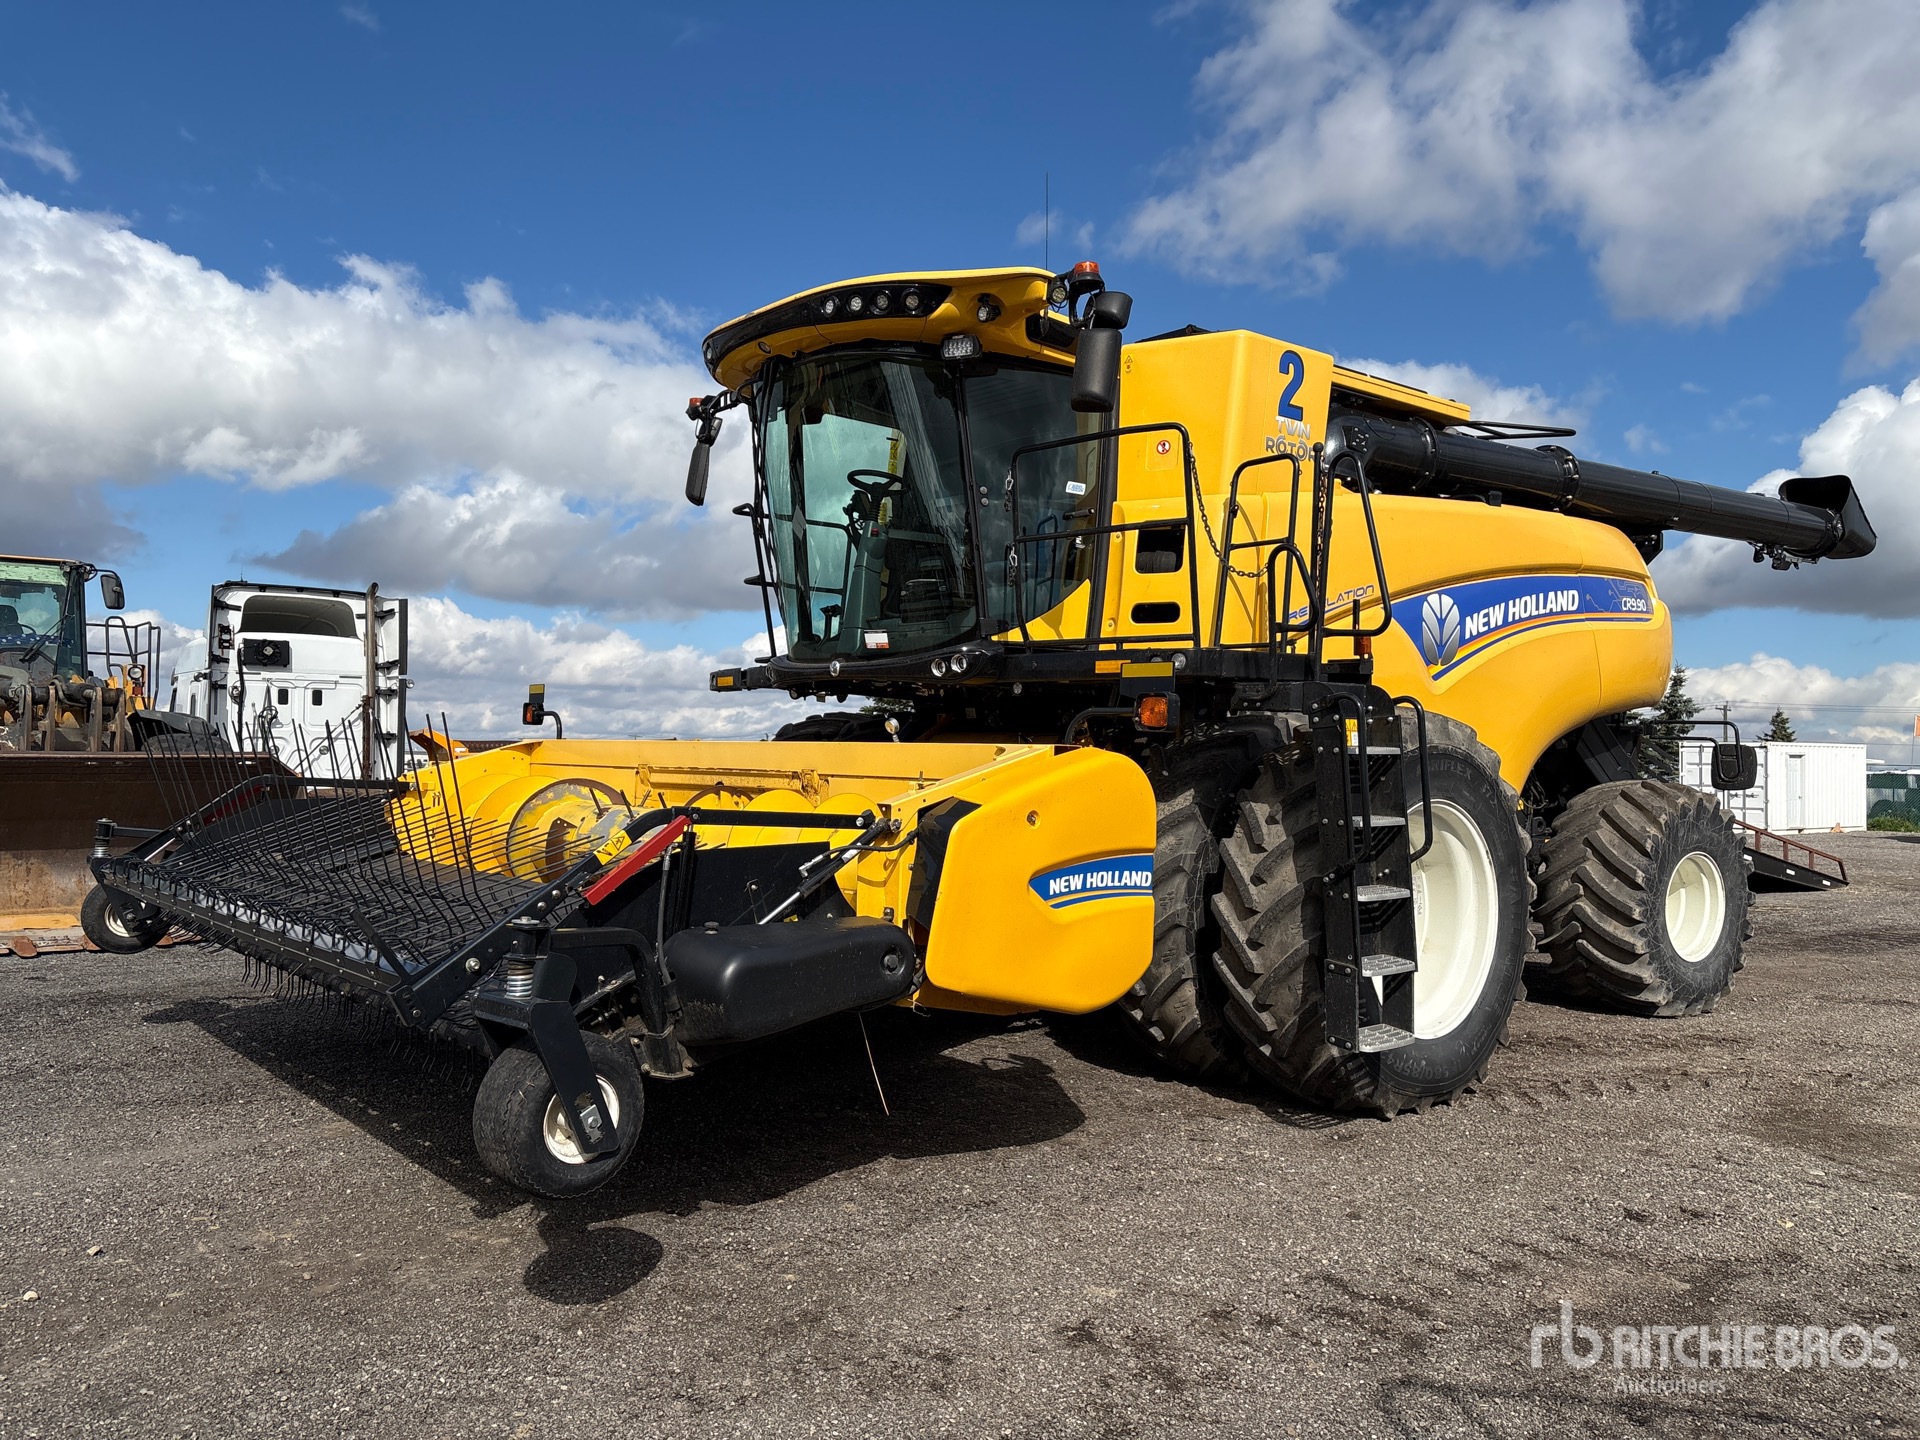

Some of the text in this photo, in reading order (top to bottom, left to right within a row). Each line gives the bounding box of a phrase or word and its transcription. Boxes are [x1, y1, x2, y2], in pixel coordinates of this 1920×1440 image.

[1278, 349, 1305, 421] 2
[1275, 415, 1311, 440] TWIN
[1288, 584, 1375, 621] RELATION
[1464, 589, 1580, 639] NEW HOLLAND
[1621, 596, 1647, 612] CR9.90
[1049, 870, 1152, 895] NEW HOLLAND
